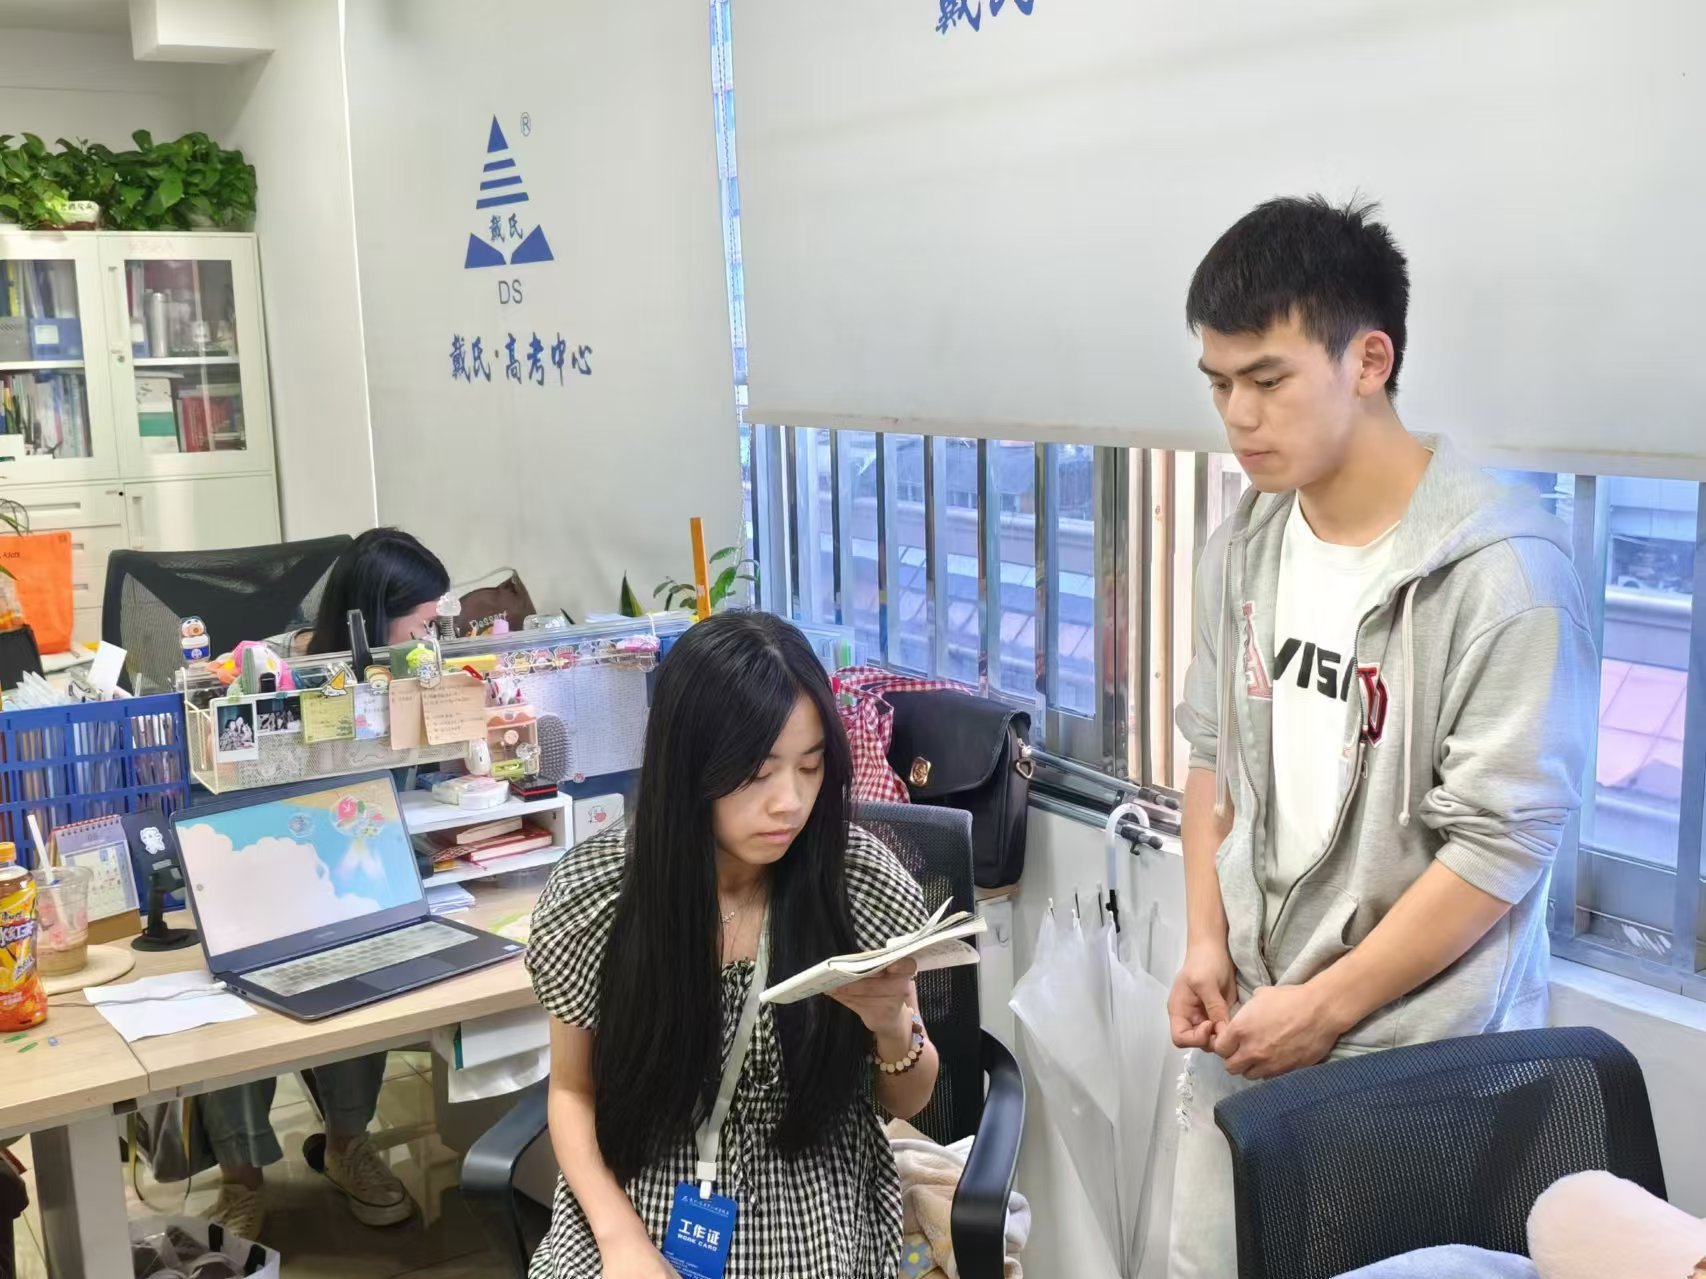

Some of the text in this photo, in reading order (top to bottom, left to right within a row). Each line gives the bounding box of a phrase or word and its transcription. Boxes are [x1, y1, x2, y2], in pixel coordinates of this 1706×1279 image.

[488, 213, 524, 243] 戴氏
[497, 279, 523, 305] DS
[677, 1233, 718, 1252] WORK CARD
[678, 1218, 721, 1246] 工作证
